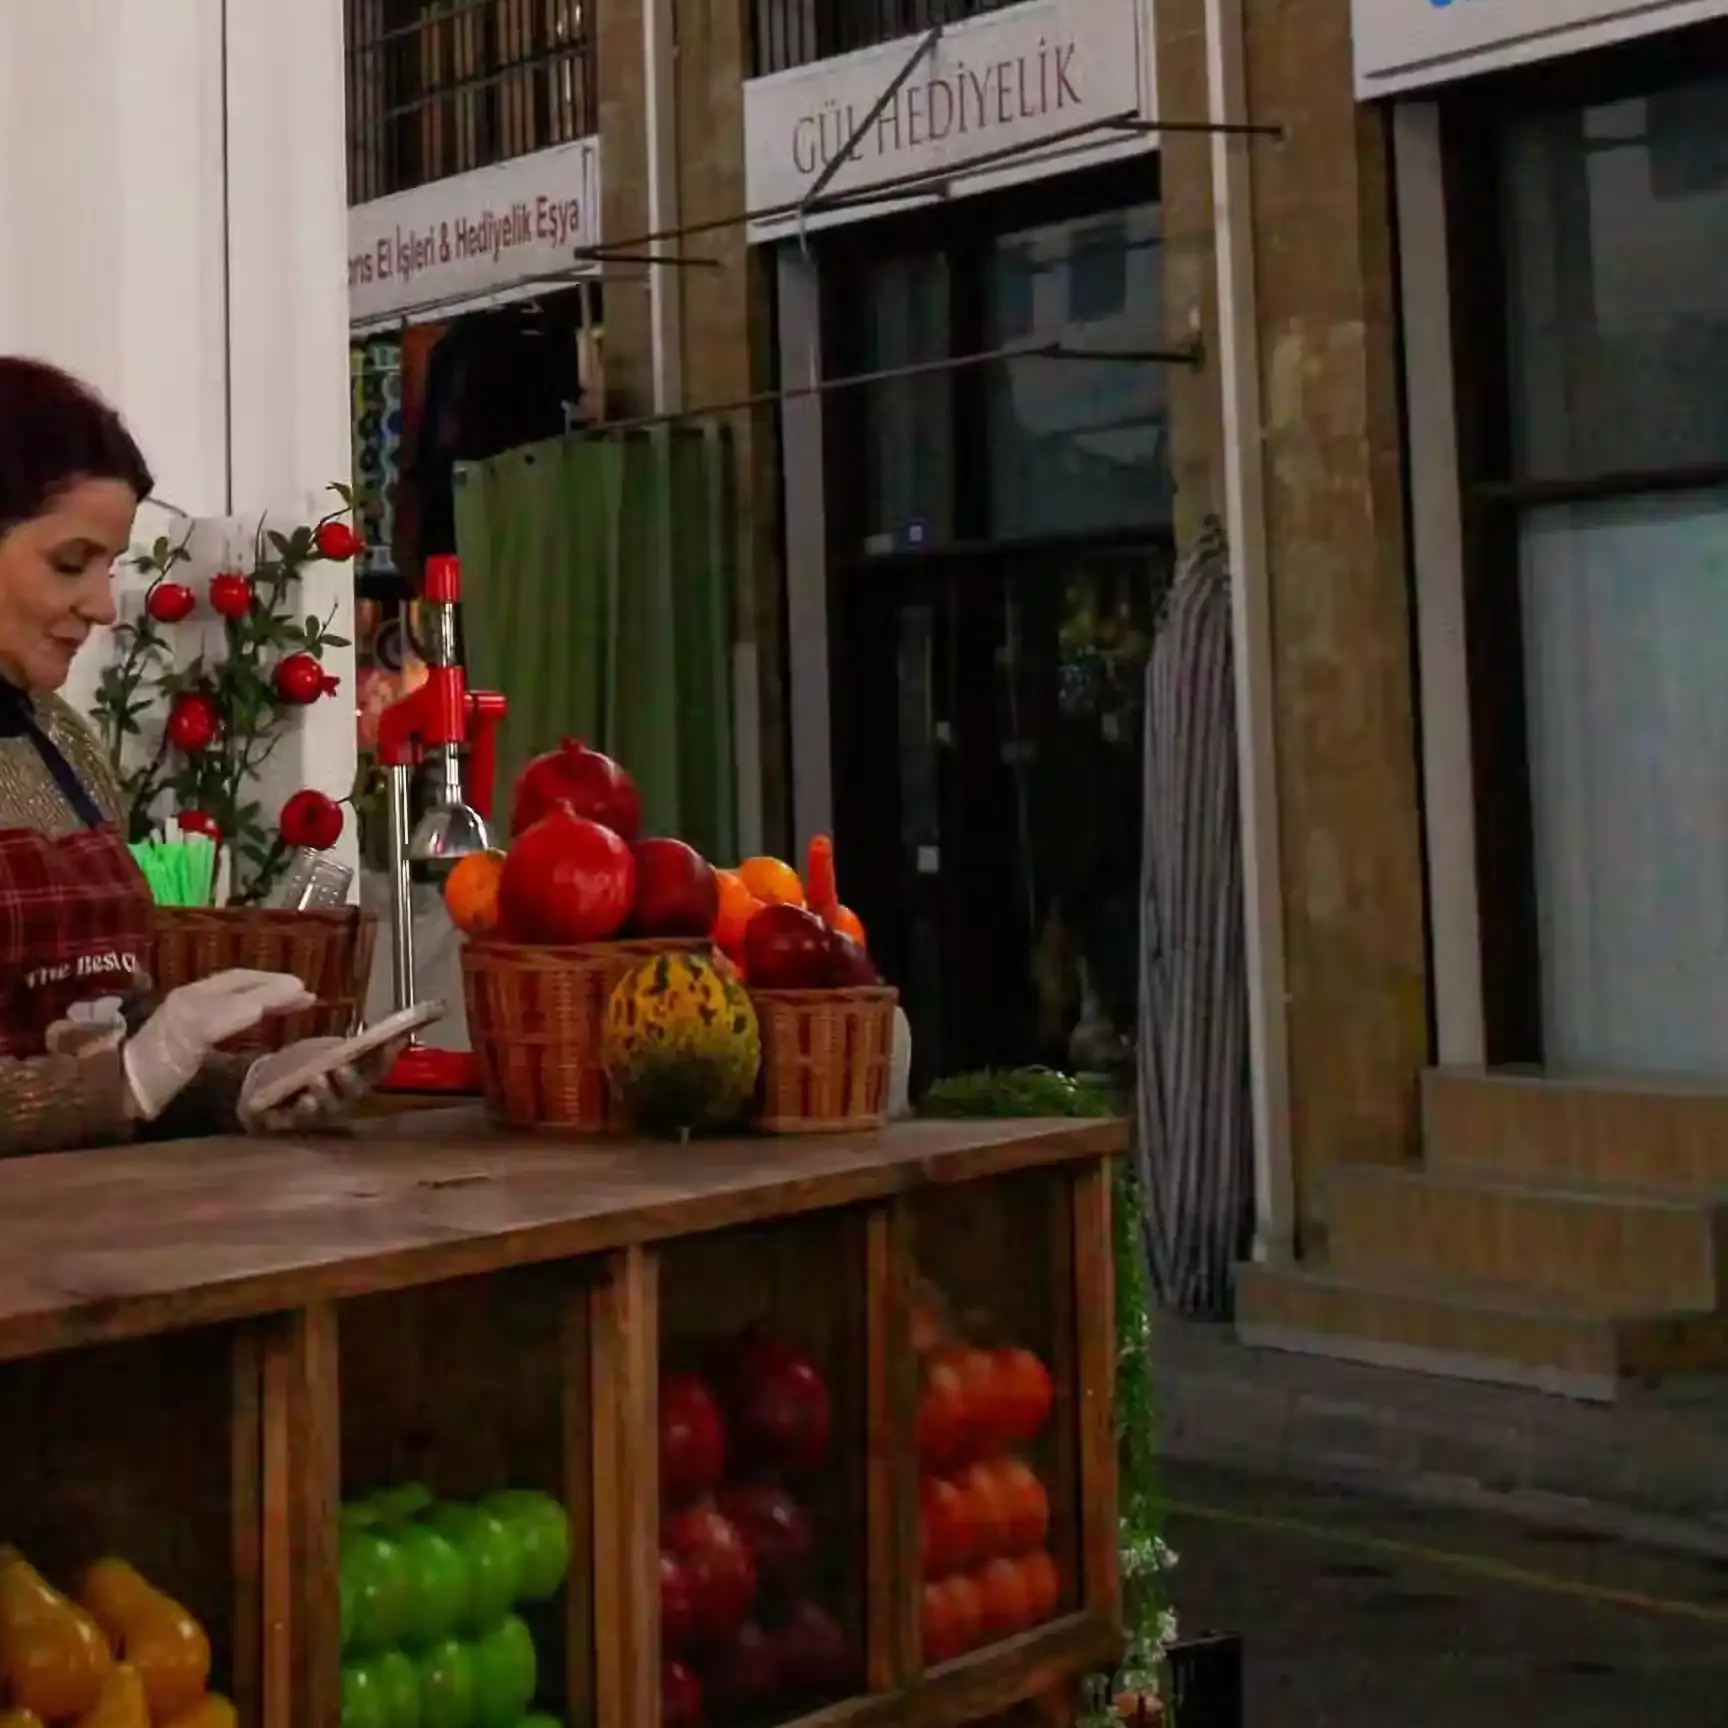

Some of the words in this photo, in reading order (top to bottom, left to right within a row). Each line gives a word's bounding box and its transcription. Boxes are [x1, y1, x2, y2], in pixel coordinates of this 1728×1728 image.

[792, 100, 864, 174] GÜL
[877, 37, 1082, 154] HEDİYELİK
[376, 237, 393, 280] El
[439, 221, 452, 264] &
[455, 203, 532, 263] Hediyelik
[536, 195, 579, 248] Eşya
[26, 963, 71, 989] The
[77, 950, 121, 976] Best
